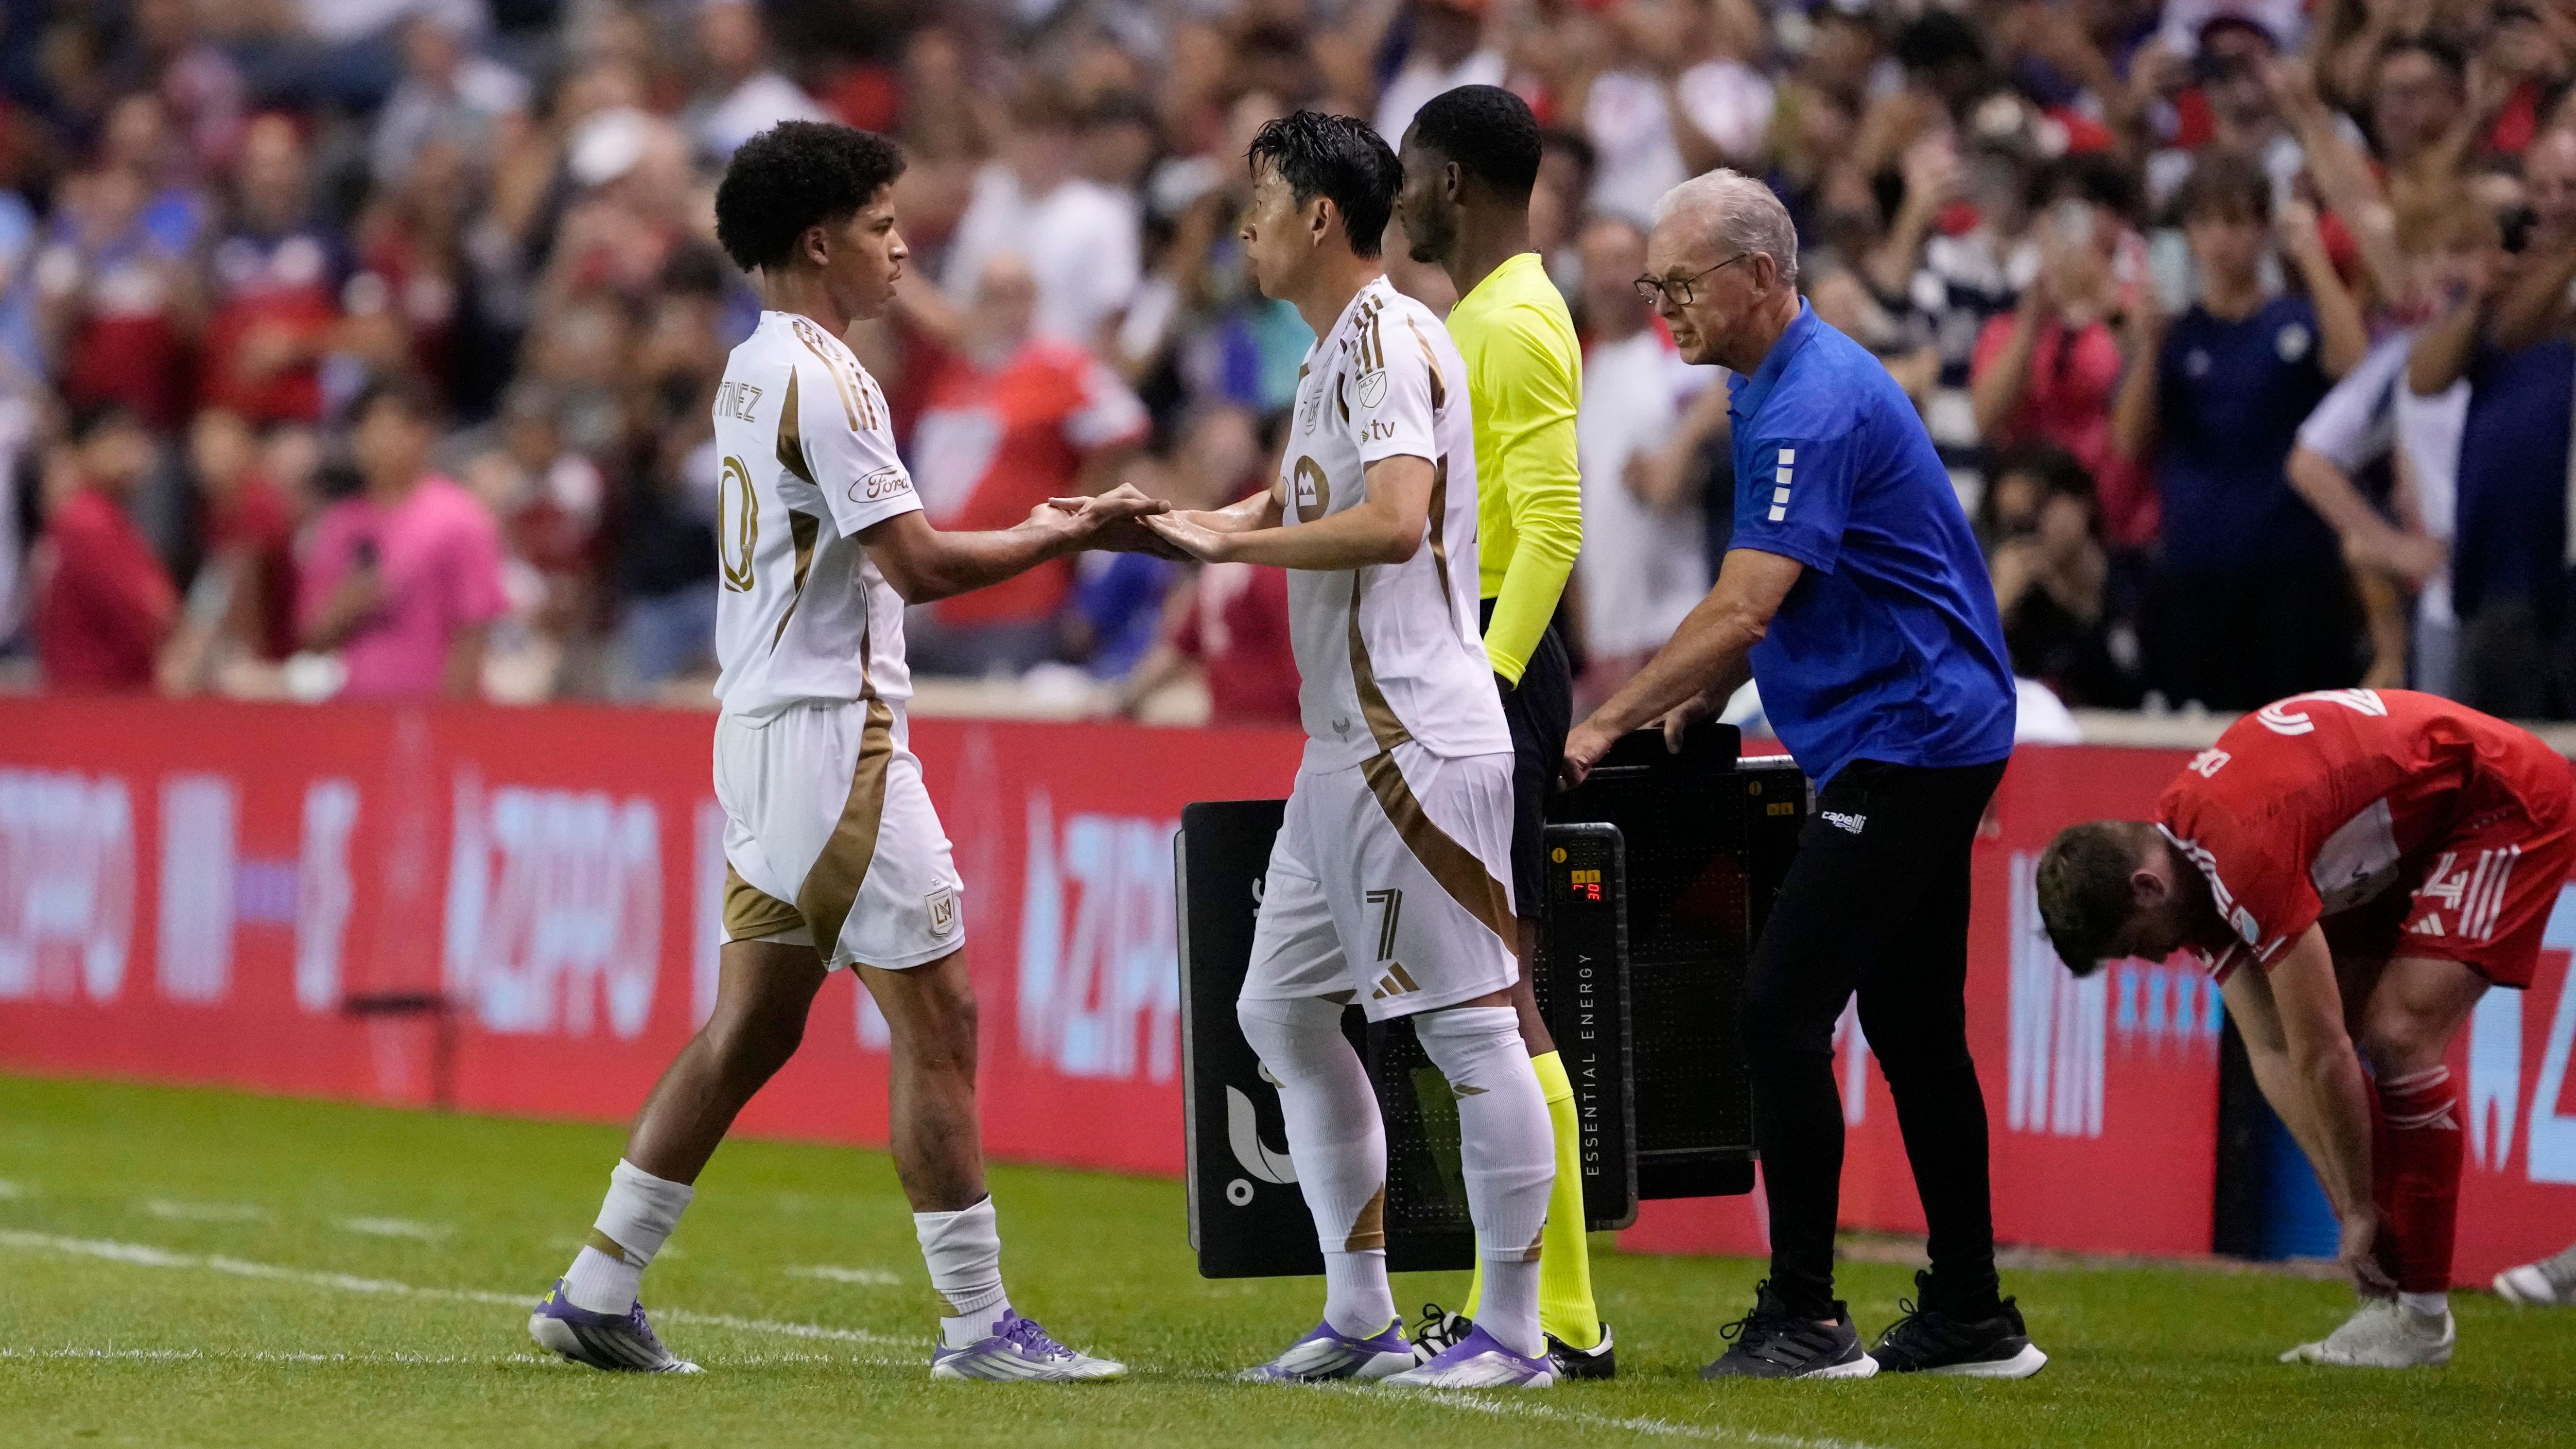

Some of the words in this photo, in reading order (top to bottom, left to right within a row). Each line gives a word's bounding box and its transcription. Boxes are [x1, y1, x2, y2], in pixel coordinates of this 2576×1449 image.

[1360, 377, 1373, 390] MLS
[1371, 419, 1395, 440] tv
[866, 469, 909, 498] Ford
[1821, 811, 1867, 830] capelli
[1588, 884, 1600, 900] 30
[1366, 888, 1403, 962] 7
[1579, 954, 1594, 1039] ENERGY
[1582, 1053, 1599, 1176] ESSENTIAL
